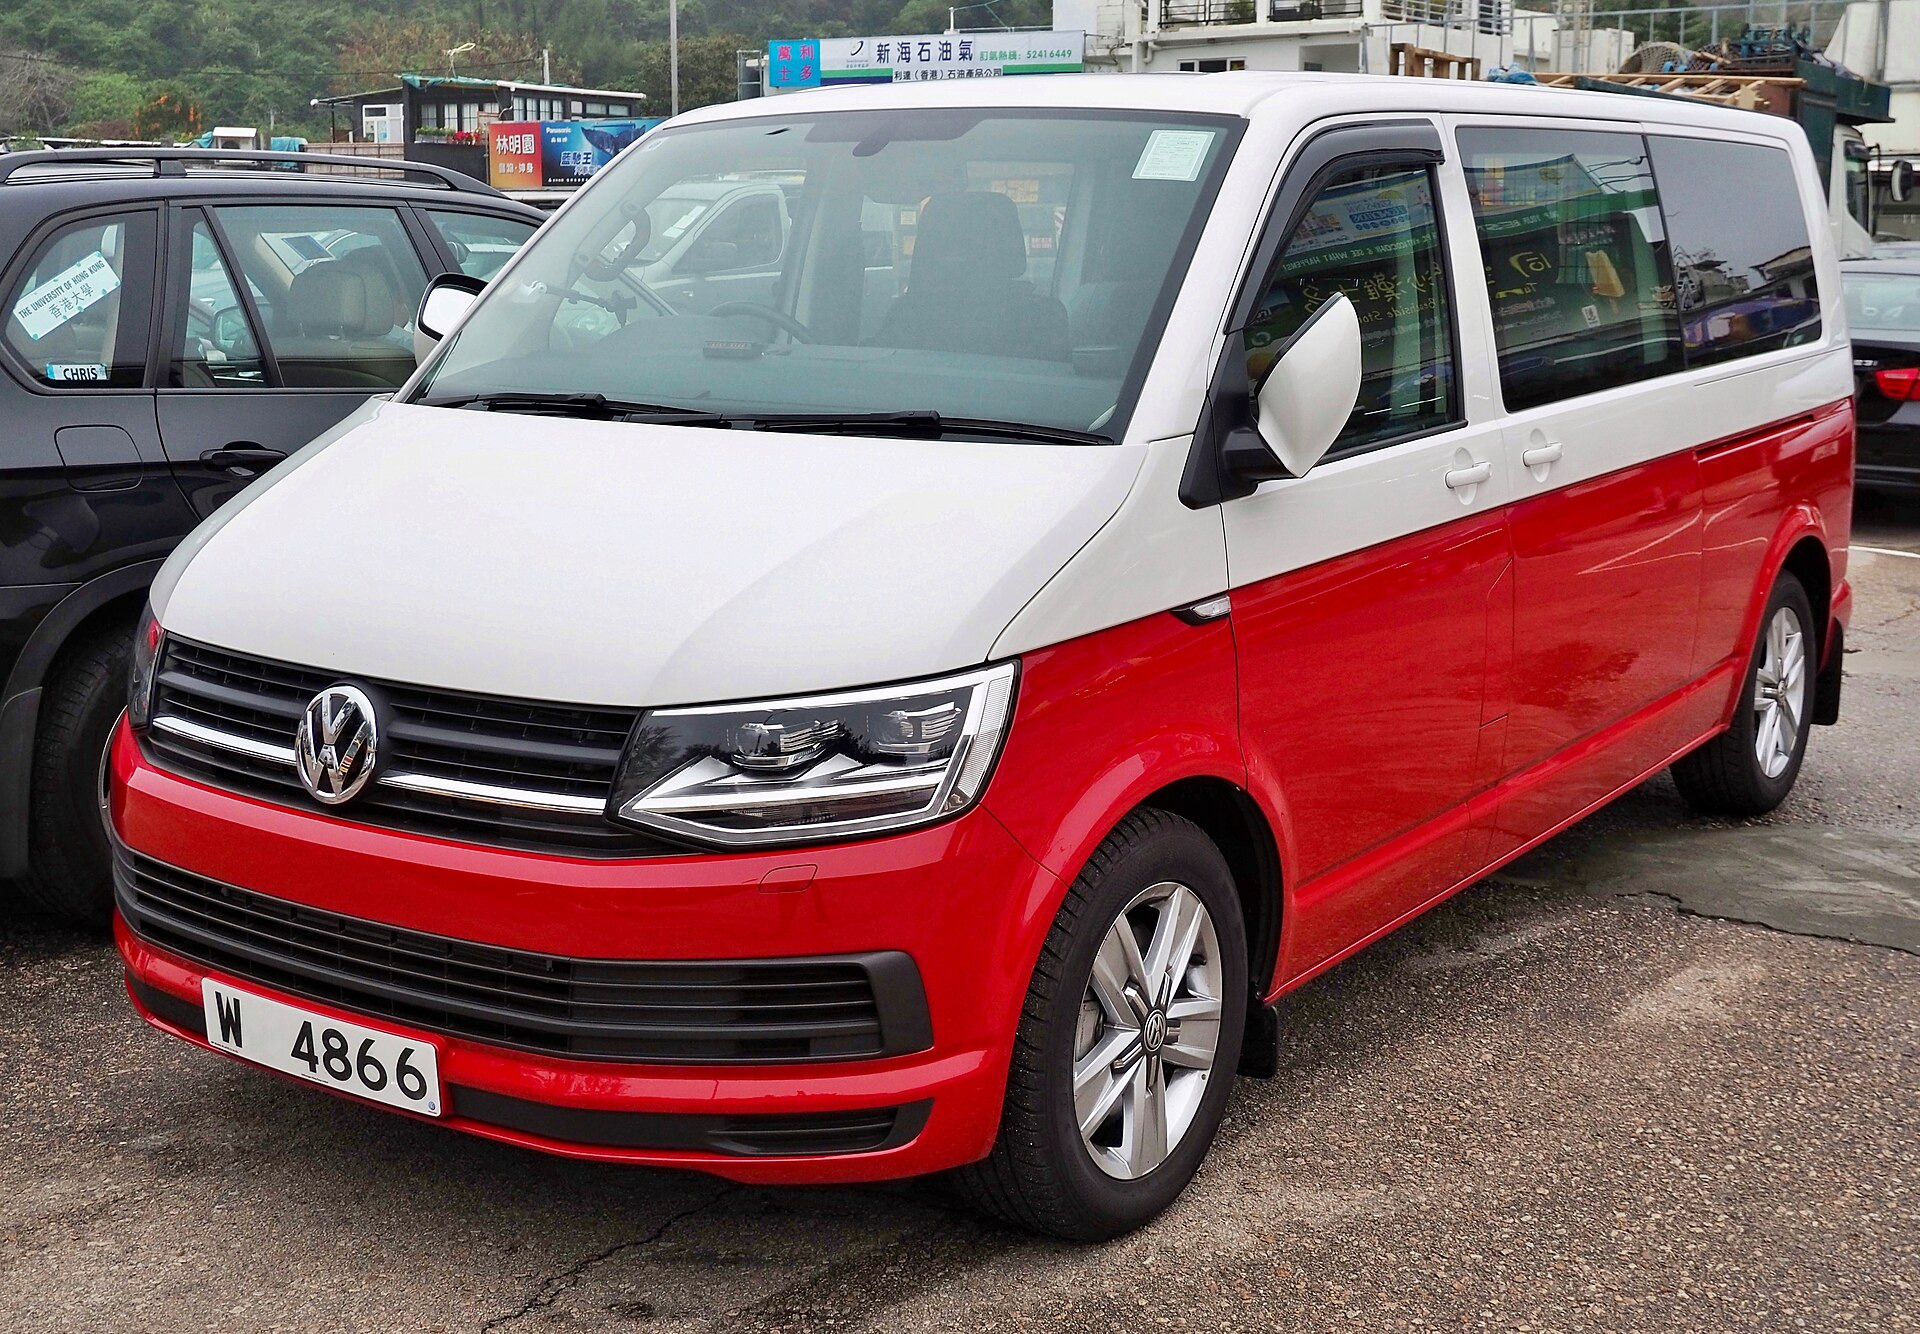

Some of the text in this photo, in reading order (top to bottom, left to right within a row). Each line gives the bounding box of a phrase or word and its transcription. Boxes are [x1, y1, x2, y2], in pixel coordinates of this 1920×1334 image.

[876, 39, 973, 64] 新海石油氣
[545, 126, 572, 135] Panasonic
[18, 260, 105, 319] THE UNIVERSITY OF HONG KONG
[49, 283, 94, 318] 香港大學
[63, 367, 98, 380] CHRIS
[215, 991, 428, 1101] W 4866
